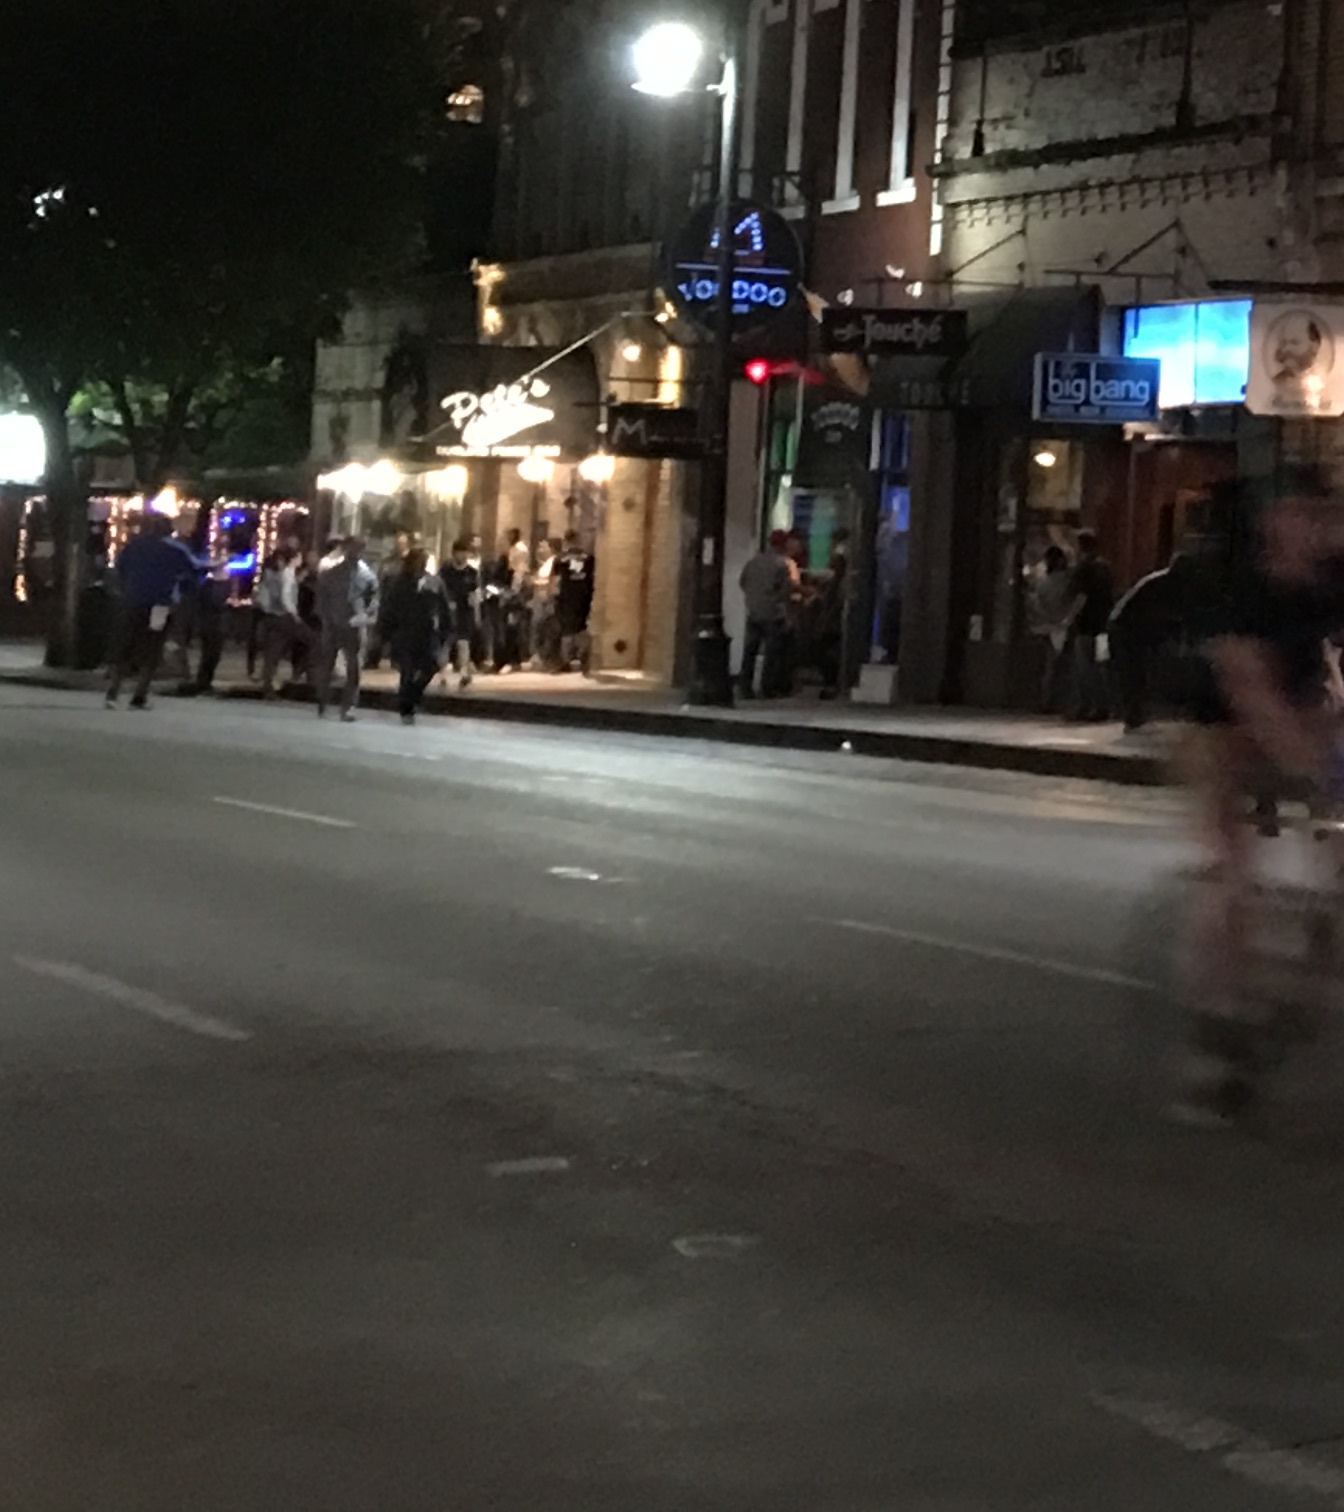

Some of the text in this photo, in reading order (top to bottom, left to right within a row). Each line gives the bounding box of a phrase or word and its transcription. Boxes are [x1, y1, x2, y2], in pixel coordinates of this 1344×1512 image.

[677, 278, 788, 308] VODOO
[1048, 359, 1150, 406] big bang
